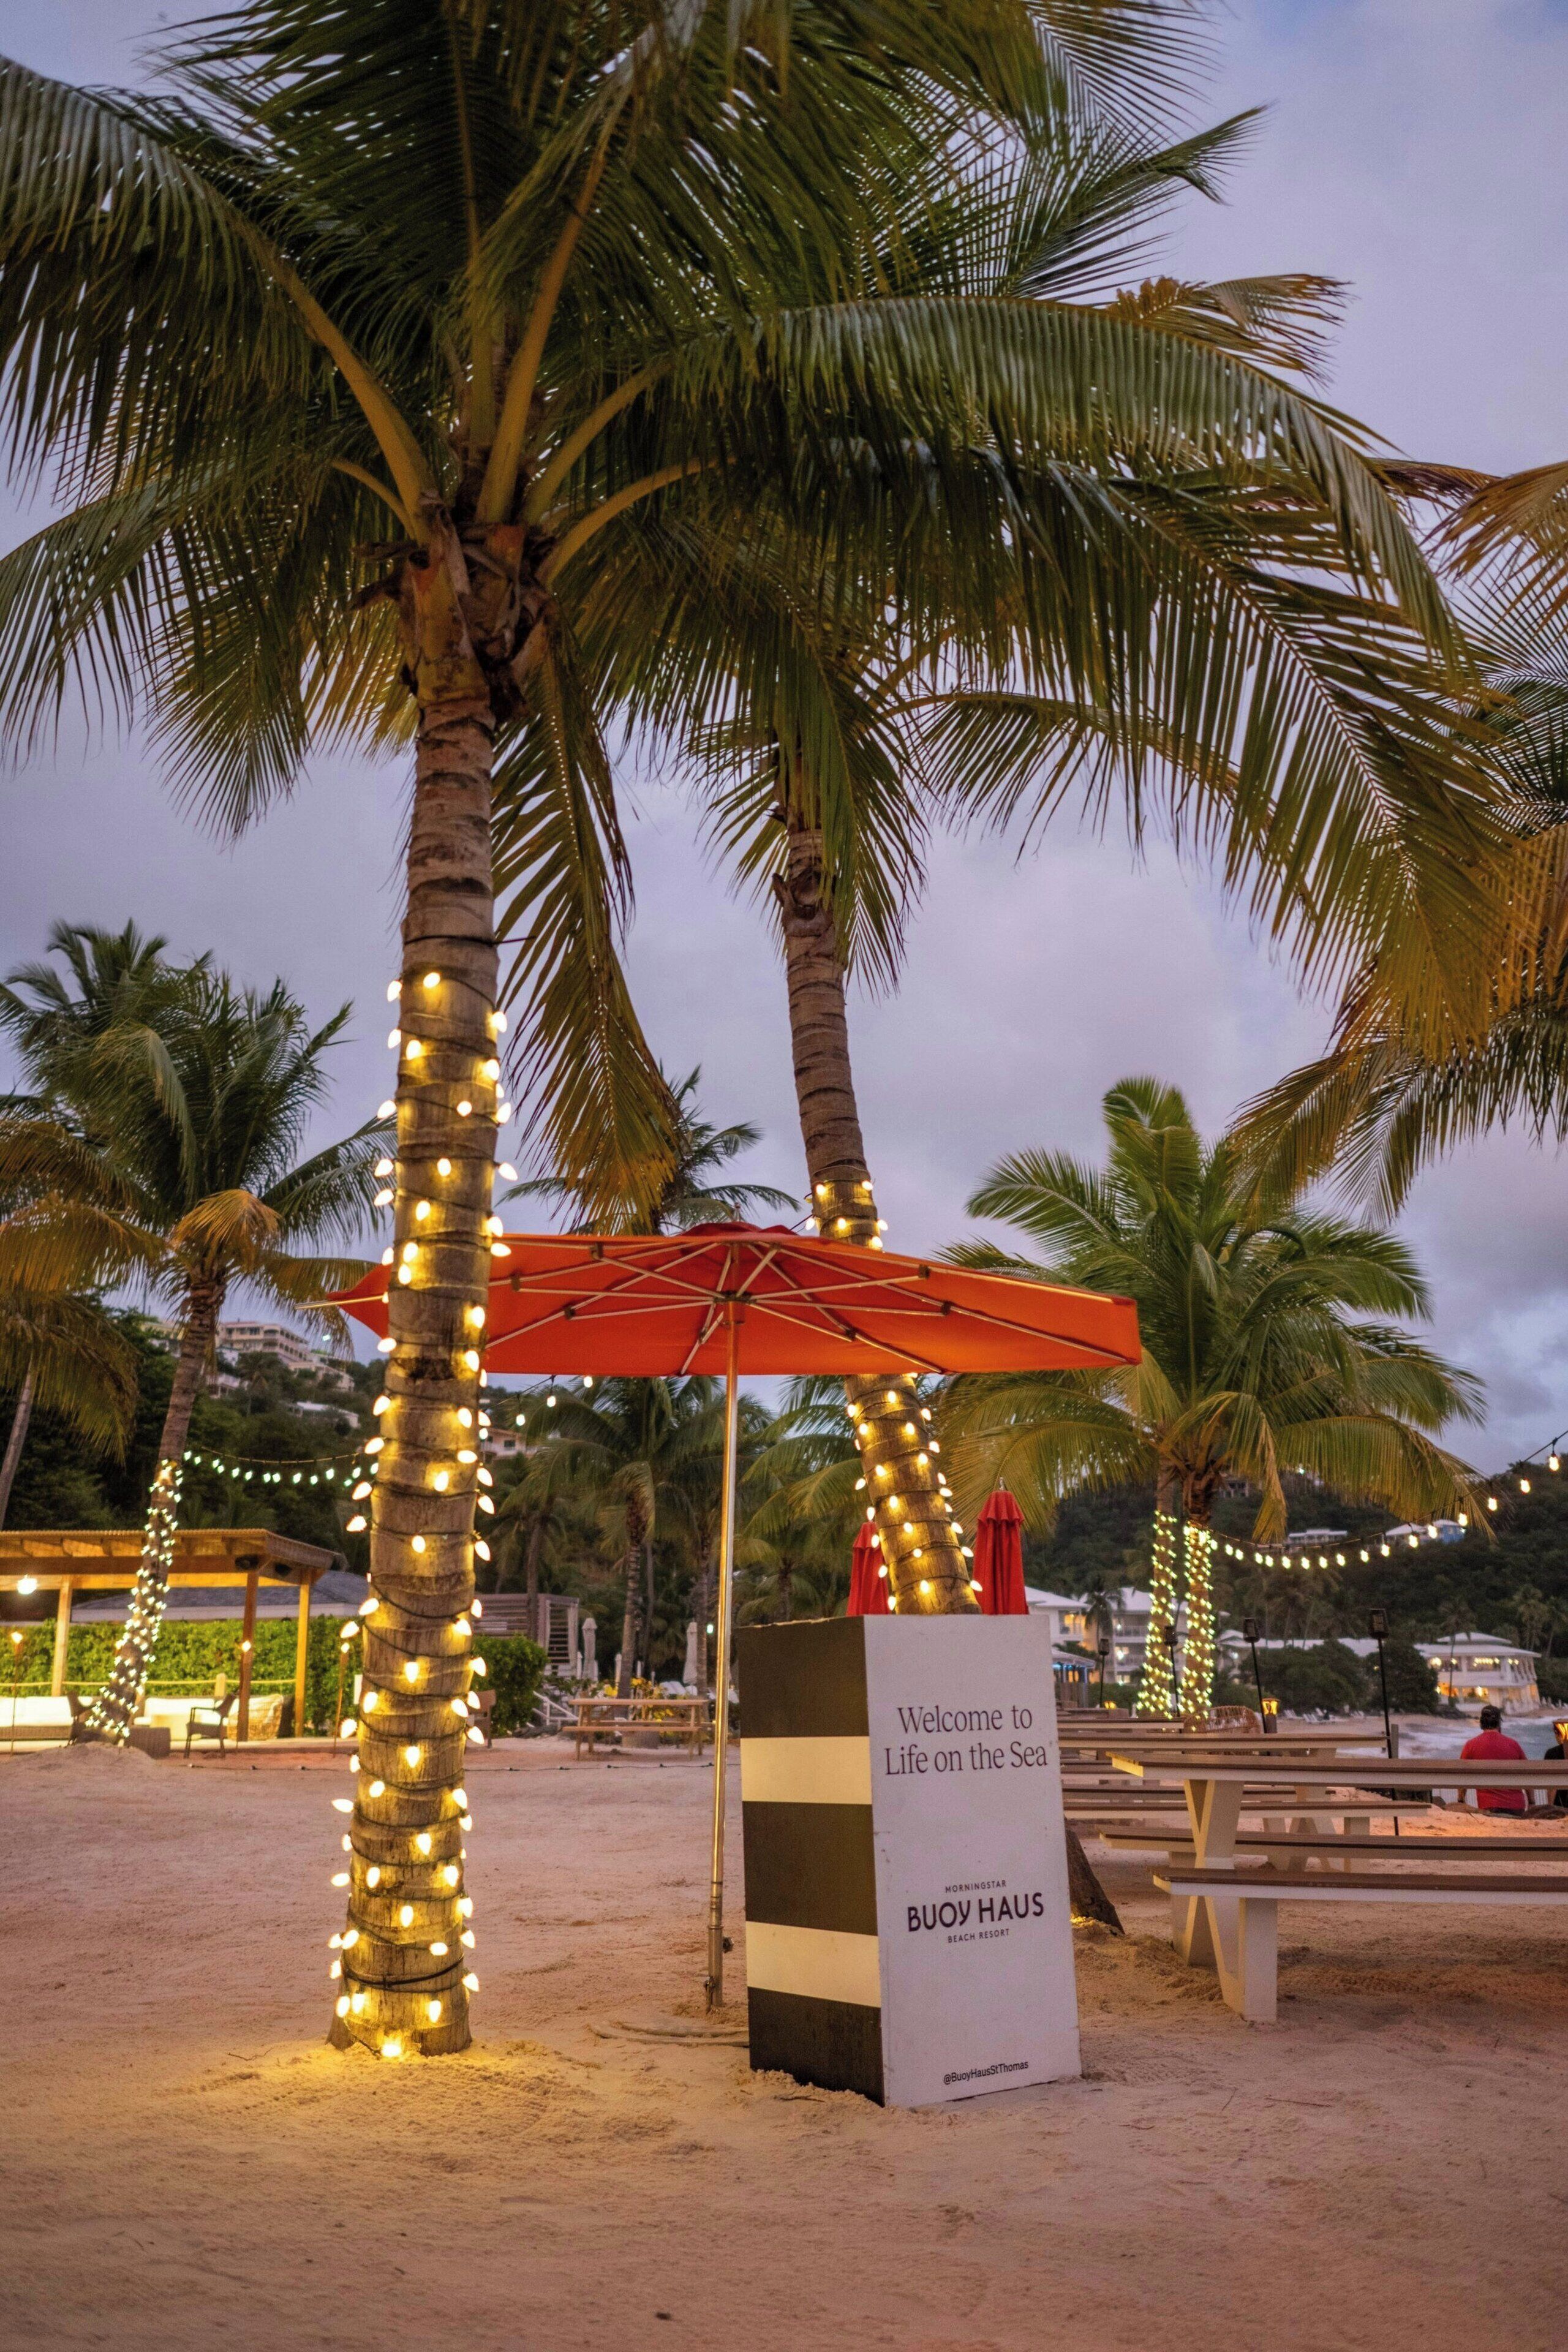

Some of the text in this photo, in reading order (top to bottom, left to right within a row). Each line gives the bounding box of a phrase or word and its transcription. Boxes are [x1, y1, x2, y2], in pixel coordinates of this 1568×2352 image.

[897, 1705, 1033, 1734] Welcome to
[884, 1741, 1048, 1775] Life on the Sea
[945, 1879, 1007, 1893] MORNINGSTAR
[908, 1892, 1044, 1932] BUOY HAUS
[948, 1928, 1010, 1943] BEACH RESORT
[943, 2061, 1029, 2085] @BuoyHausStThomas
